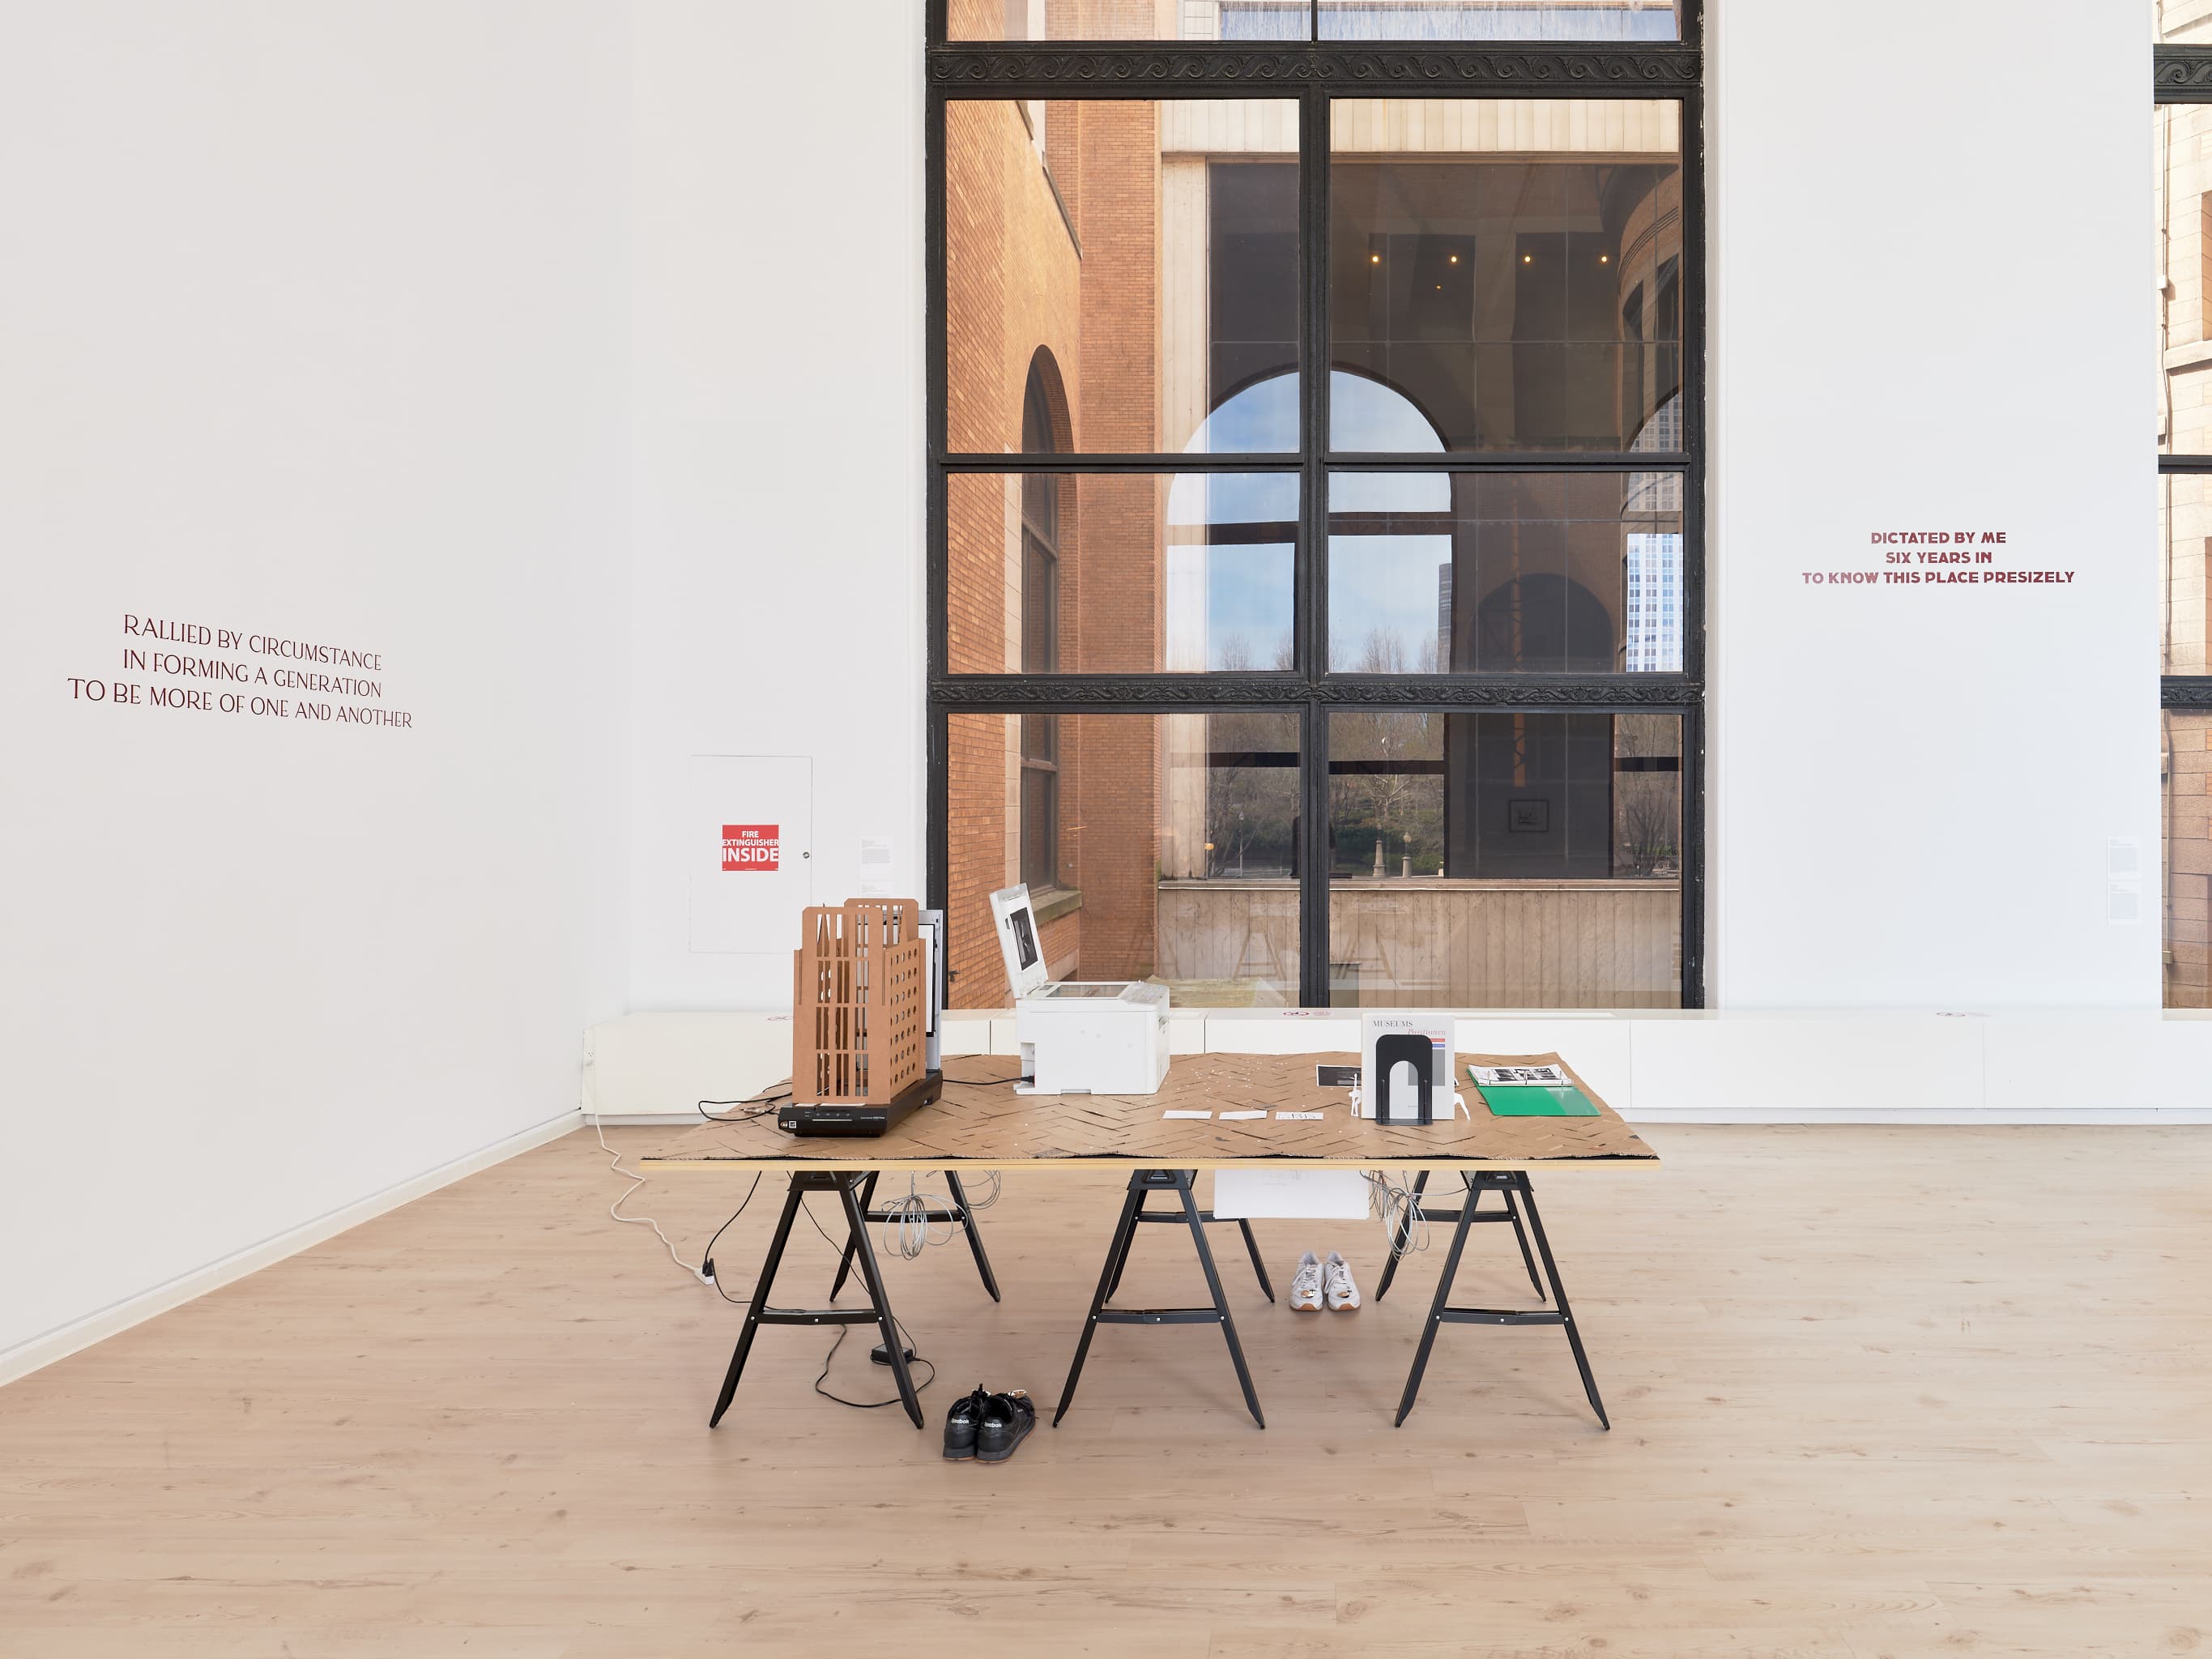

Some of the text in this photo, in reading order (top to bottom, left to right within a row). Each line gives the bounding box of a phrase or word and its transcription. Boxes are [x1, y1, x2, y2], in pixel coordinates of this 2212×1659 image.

[1871, 531, 2007, 544] DICTATED BY ME
[1885, 552, 1993, 565] SIX YEARS IN
[1801, 571, 2075, 584] TO KNOW THIS PLACE PRESIZELY
[124, 613, 382, 672] RALLIED BY CIRCUMSTANCE
[123, 648, 381, 699] IN FORMING A GENERATION
[66, 677, 413, 728] TO BE MORE OF ONE AND ANOTHER
[722, 838, 779, 847] EXTINGUISHER
[722, 847, 779, 862] INSIDE
